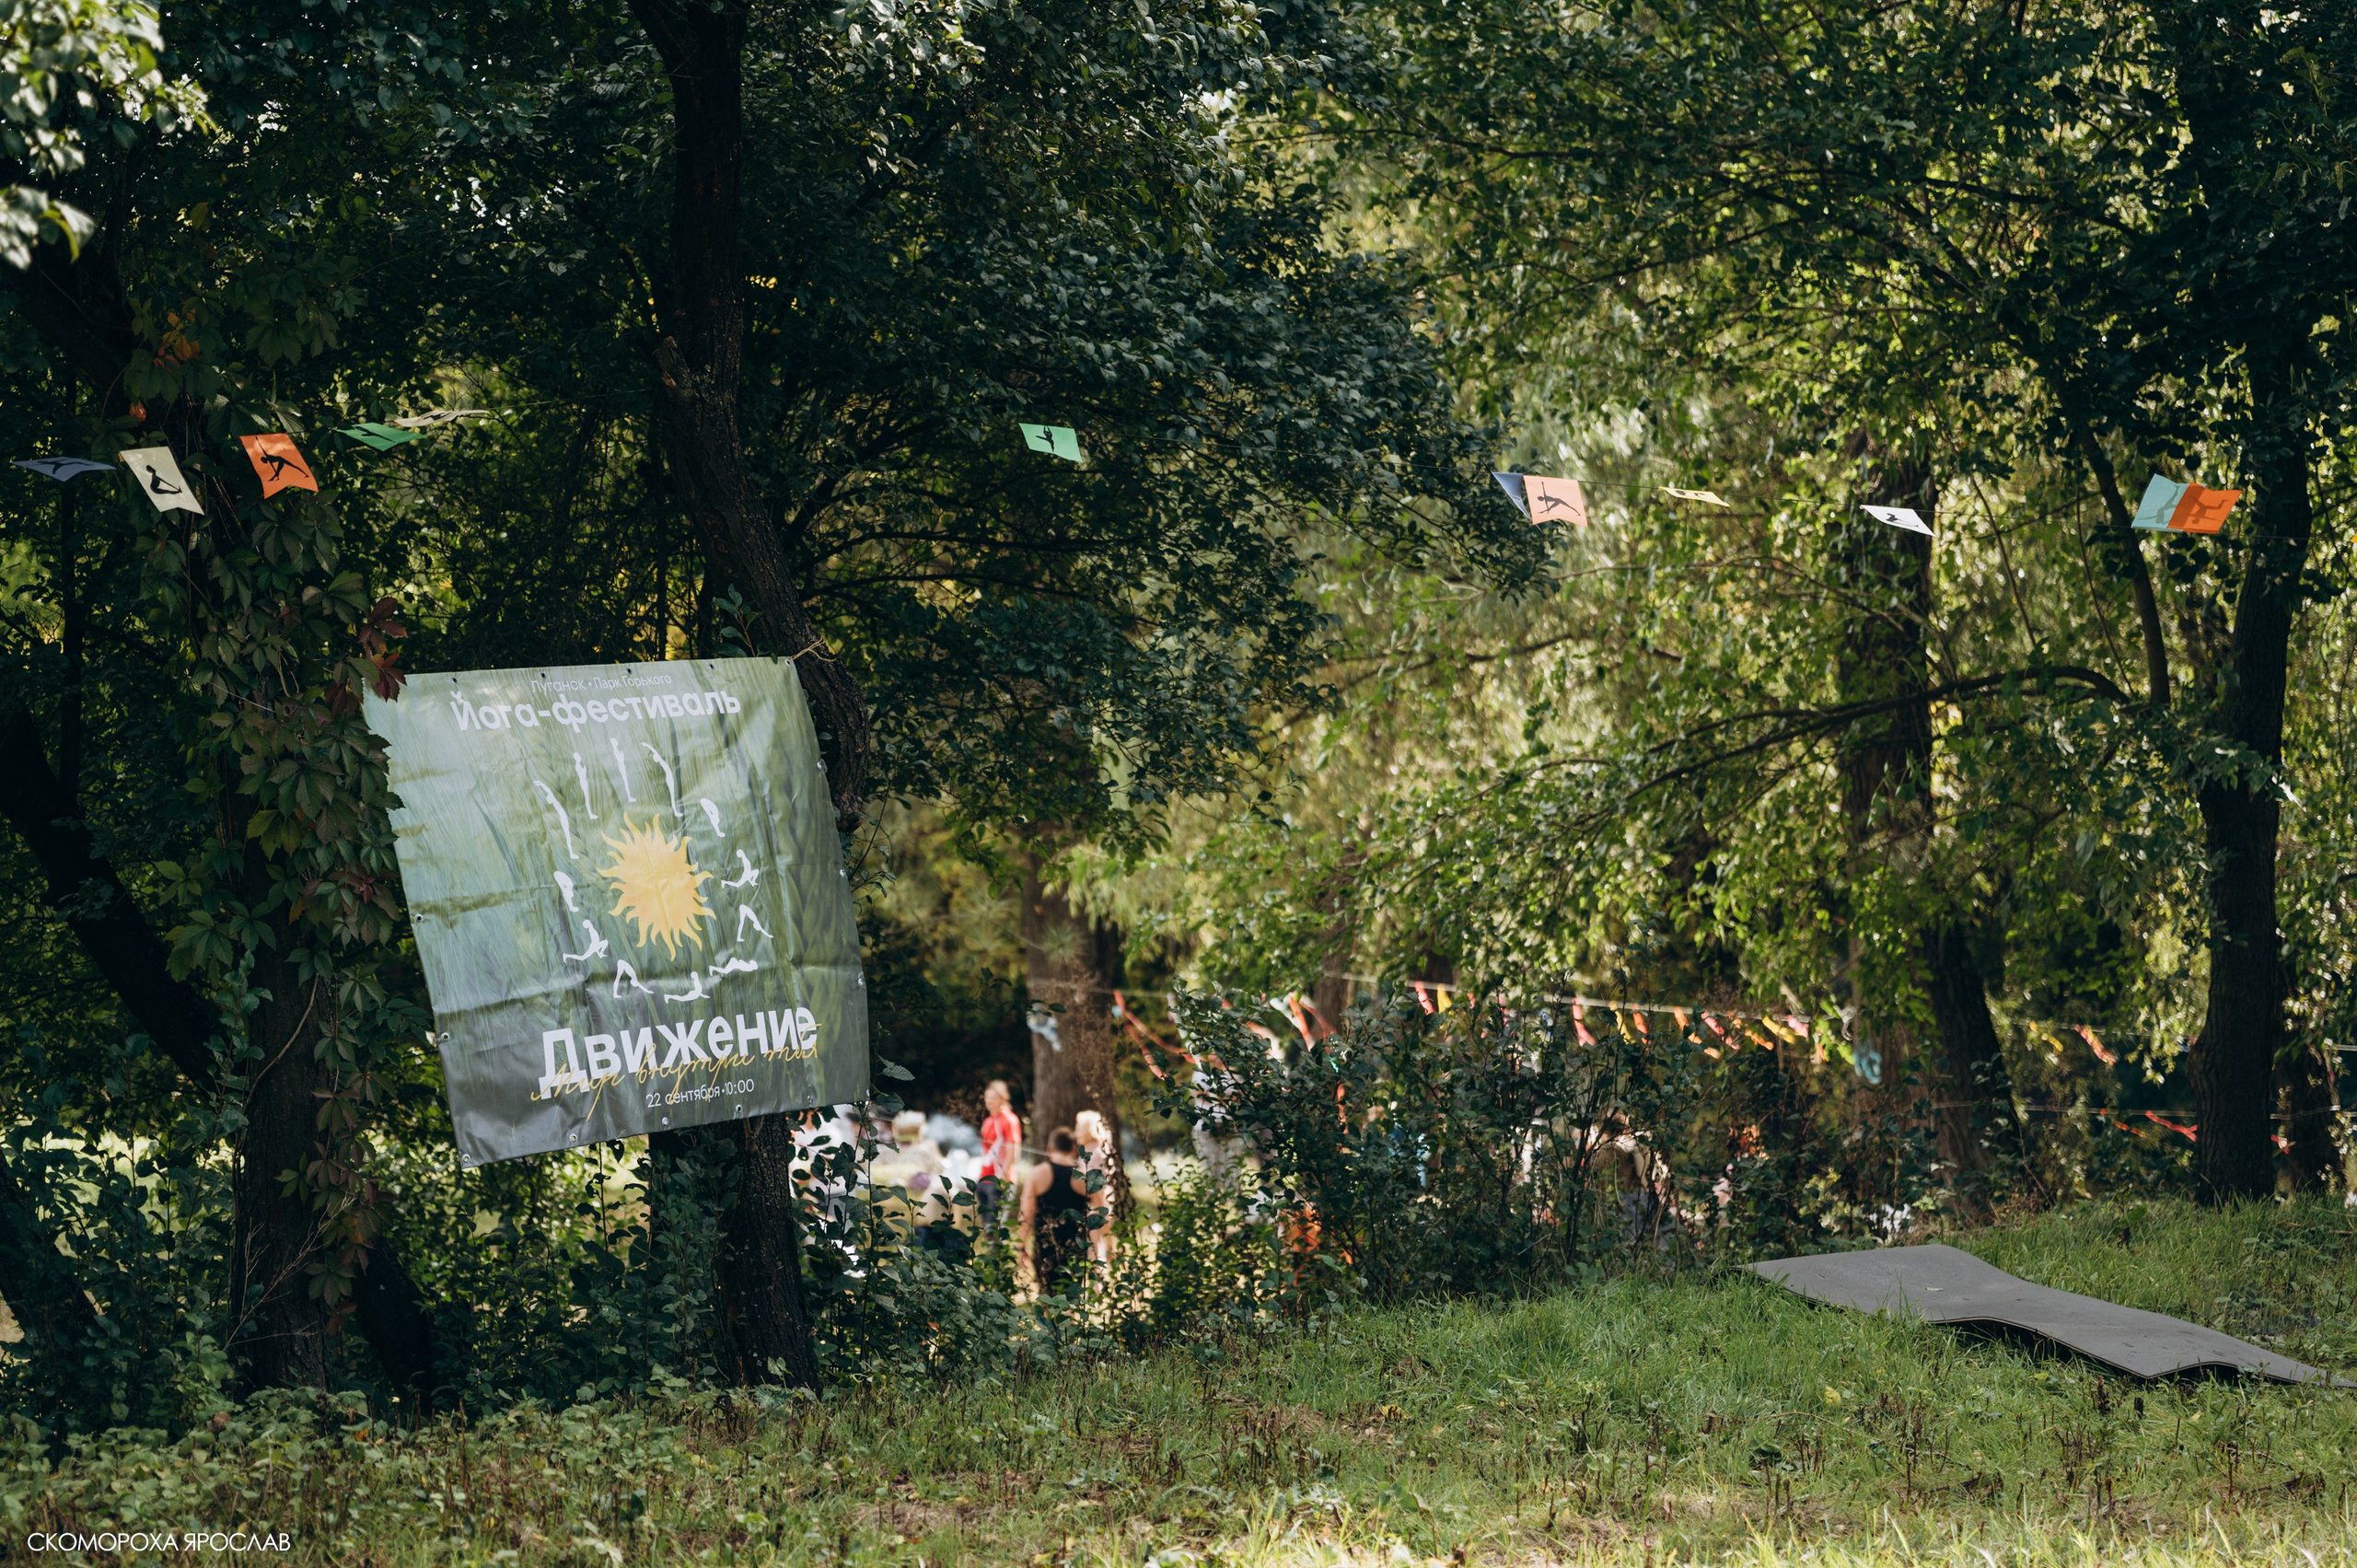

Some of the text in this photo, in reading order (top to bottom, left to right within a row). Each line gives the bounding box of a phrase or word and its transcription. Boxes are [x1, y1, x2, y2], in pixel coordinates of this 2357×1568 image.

[531, 674, 672, 696] Луганск Парк Горького
[449, 691, 741, 733] Йога-фестиваль
[538, 1006, 818, 1099] Движение
[530, 1063, 625, 1122] Мир
[635, 1042, 755, 1105] внутри
[646, 1078, 755, 1108] 22 сентября 10:00
